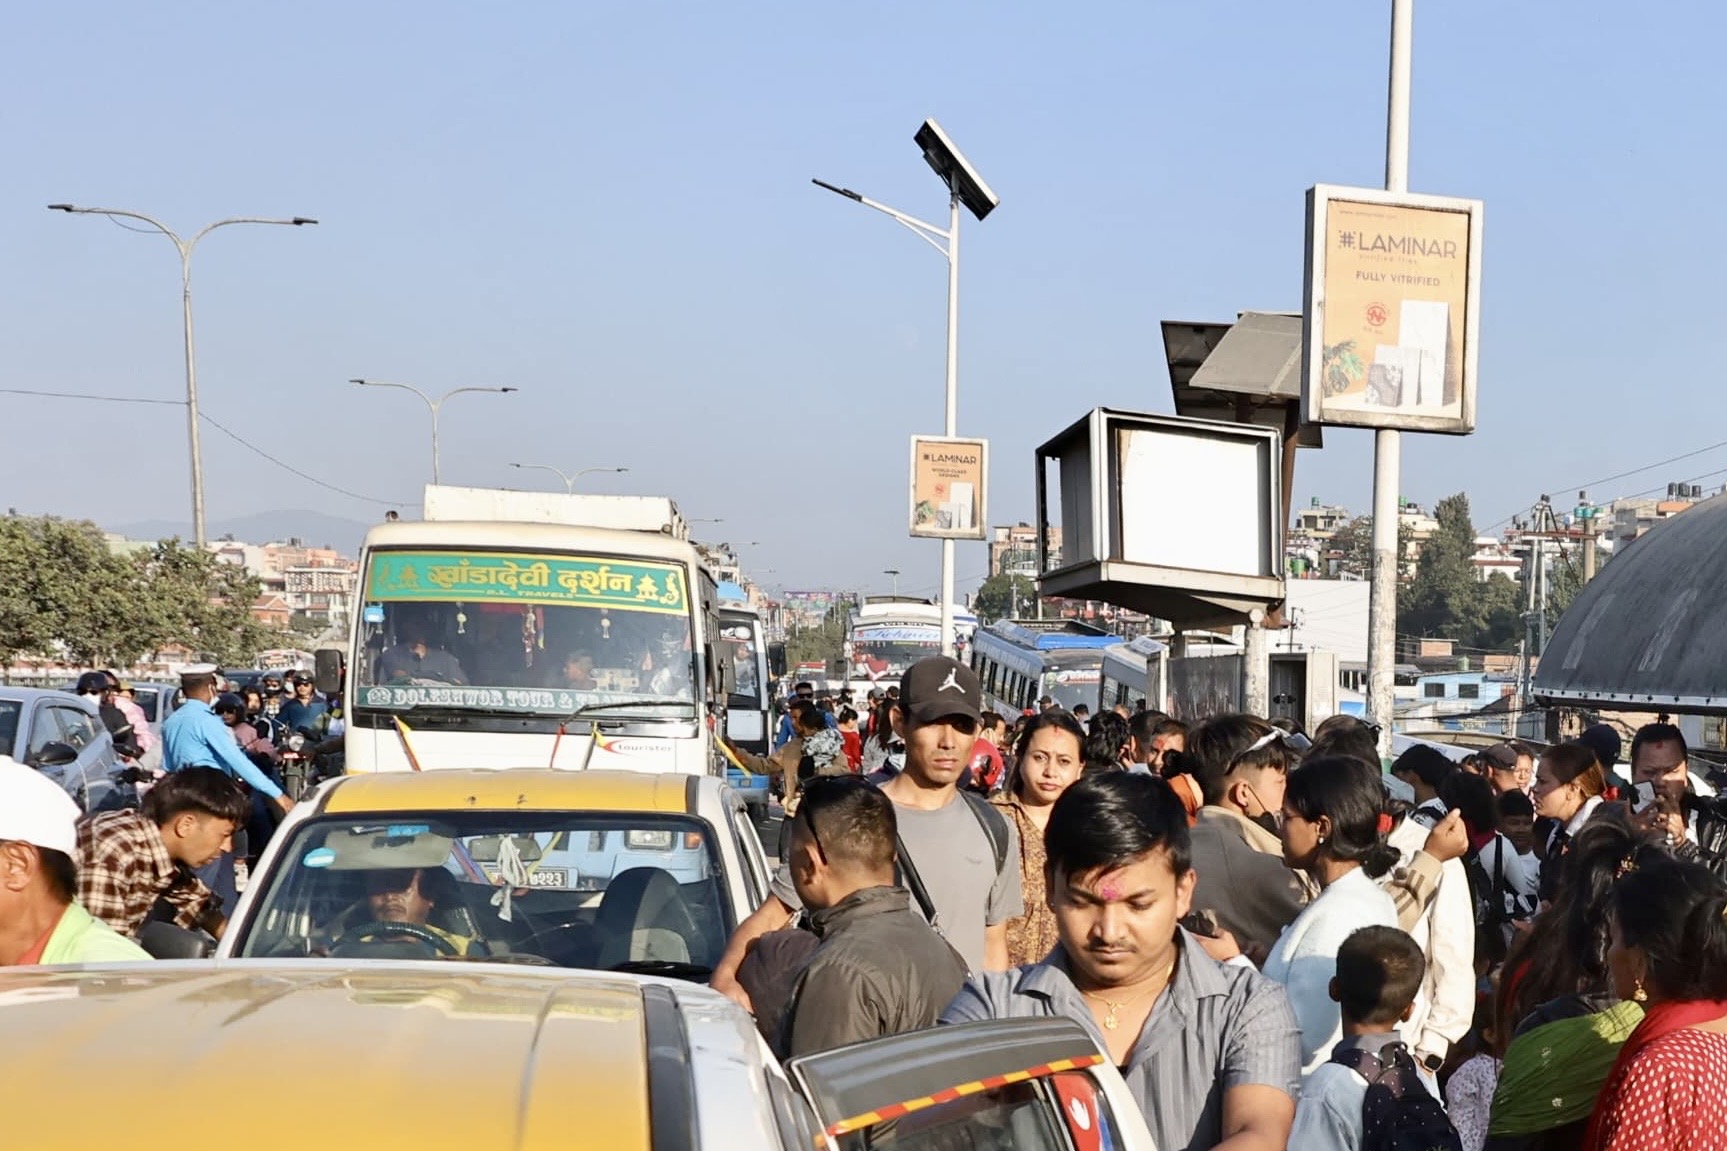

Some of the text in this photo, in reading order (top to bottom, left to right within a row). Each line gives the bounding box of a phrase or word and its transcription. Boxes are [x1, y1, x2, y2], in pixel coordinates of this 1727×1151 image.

[1355, 270, 1441, 287] FULLY VITRIFIED
[558, 566, 634, 595] दर्शन
[509, 690, 556, 709] TOUR
